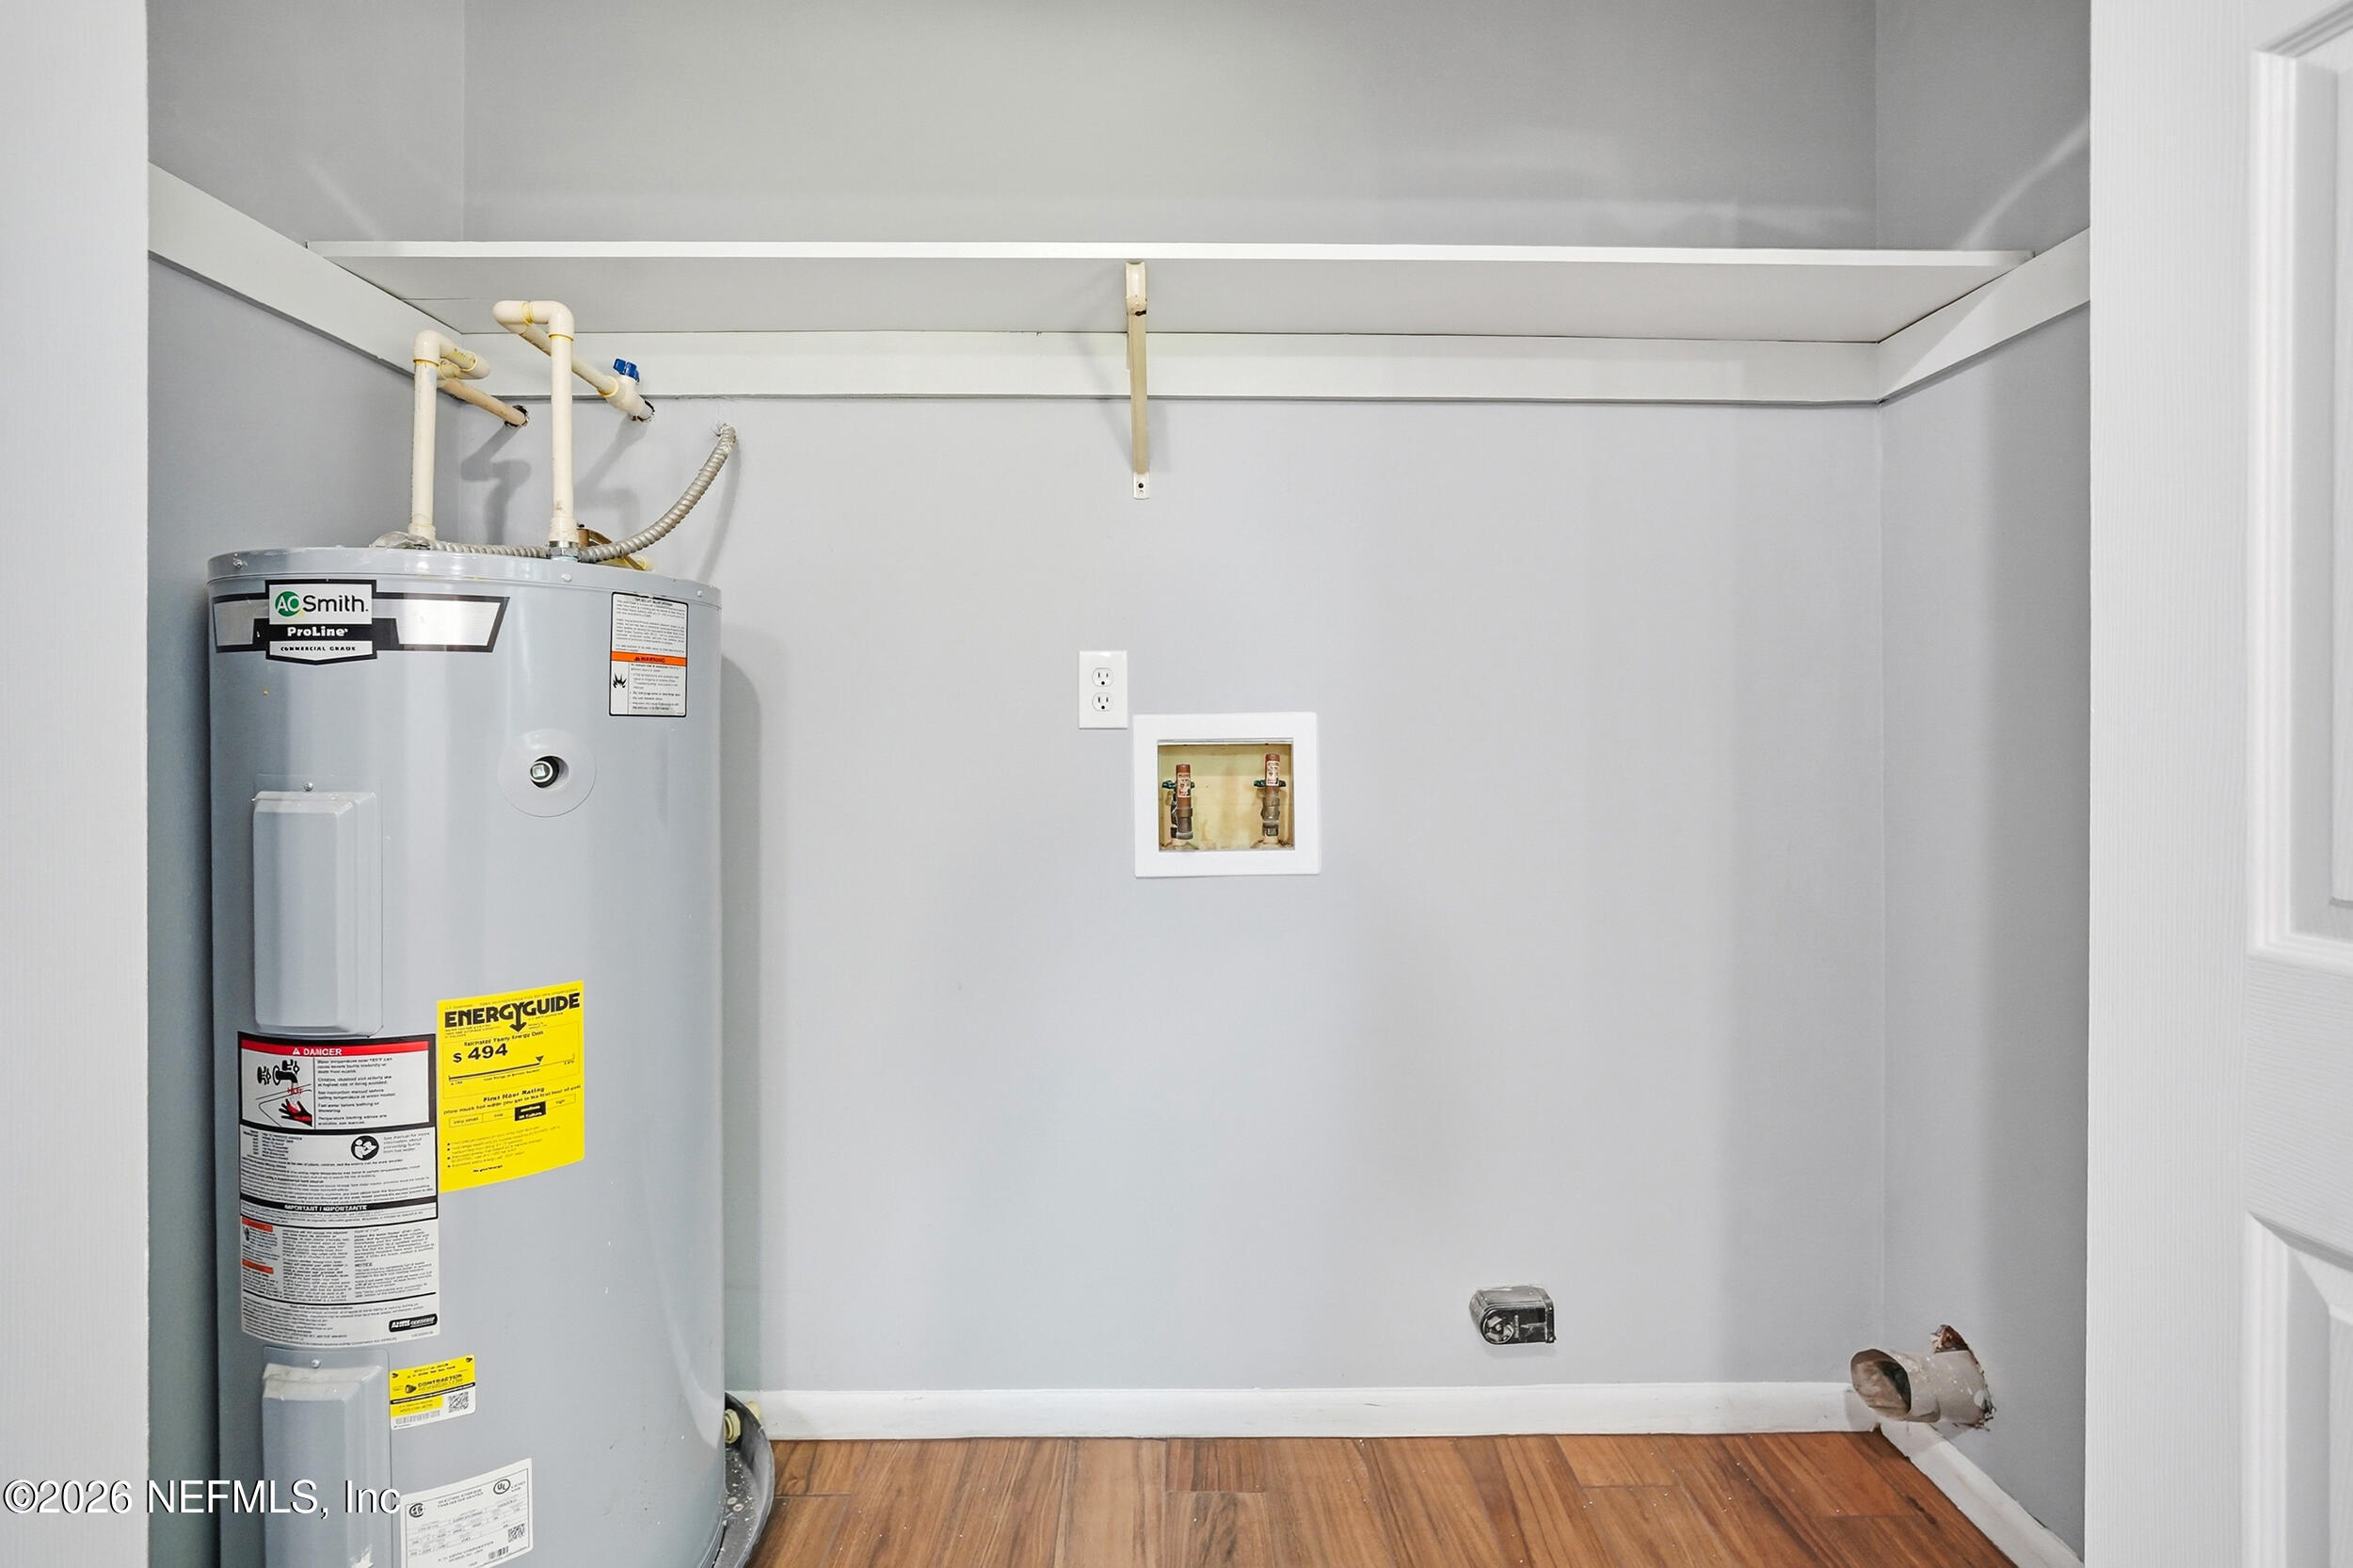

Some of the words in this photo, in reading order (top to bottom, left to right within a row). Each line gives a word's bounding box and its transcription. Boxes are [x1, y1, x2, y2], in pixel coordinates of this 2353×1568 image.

[287, 626, 348, 637] ProLine
[444, 992, 580, 1032] ENERGYGUIDE
[303, 1048, 343, 1056] DANGER
[468, 1043, 508, 1060] 494
